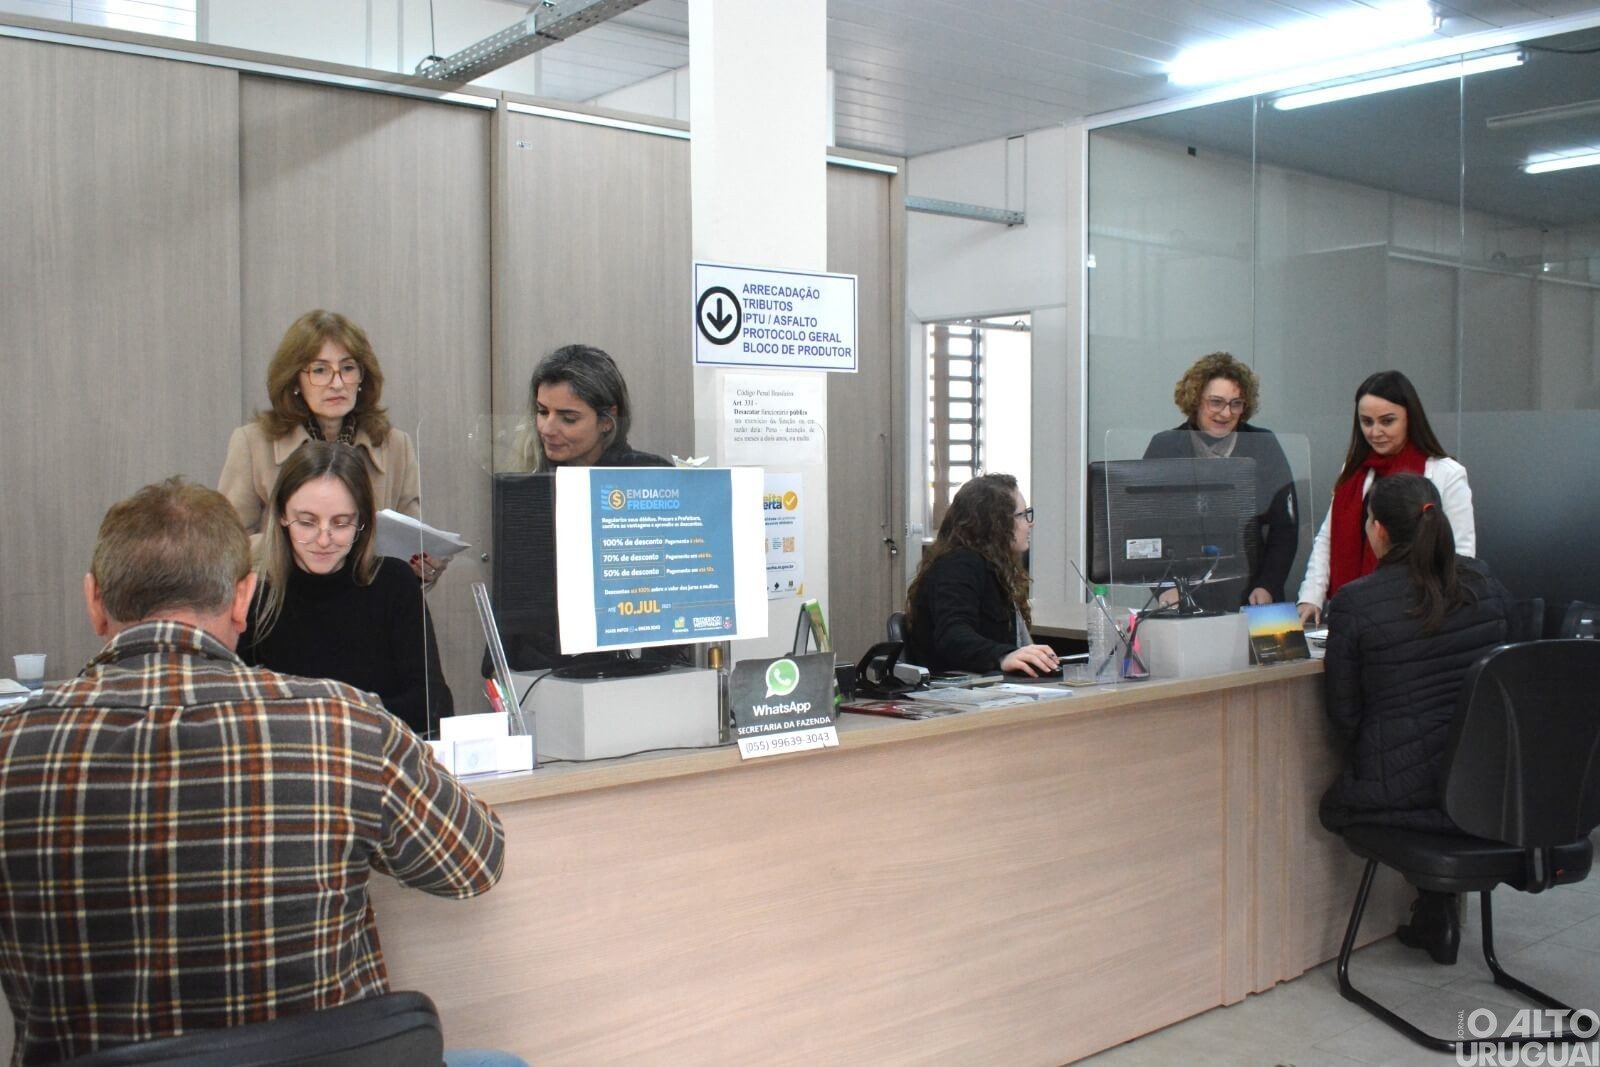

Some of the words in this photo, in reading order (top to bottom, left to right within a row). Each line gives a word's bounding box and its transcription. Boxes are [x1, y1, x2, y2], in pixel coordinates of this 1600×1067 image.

[743, 283, 820, 300] ARRECADAÇÃO
[743, 298, 793, 312] TRIBUTOS
[743, 312, 765, 324] IPTU
[768, 314, 771, 325] /
[773, 315, 817, 327] ASFALTO
[743, 327, 806, 341] PROTOCOLO
[809, 332, 842, 343] GERAL
[743, 342, 779, 354] BLOCO
[782, 344, 794, 354] DE
[798, 345, 852, 357] PRODUTOR
[627, 500, 680, 510] FREDERICO
[602, 538, 624, 547] 100%
[634, 538, 662, 546] desconto
[603, 554, 619, 562] 70%
[603, 569, 620, 578] 50%
[631, 568, 660, 576] desconto
[617, 600, 660, 616] 10.JUL
[752, 701, 811, 716] WhatsApp
[738, 722, 782, 735] SECRETARIA
[784, 720, 795, 729] DA
[796, 716, 831, 727] FAZENDA
[746, 740, 770, 753] (055)
[772, 732, 830, 748] 99639-3043
